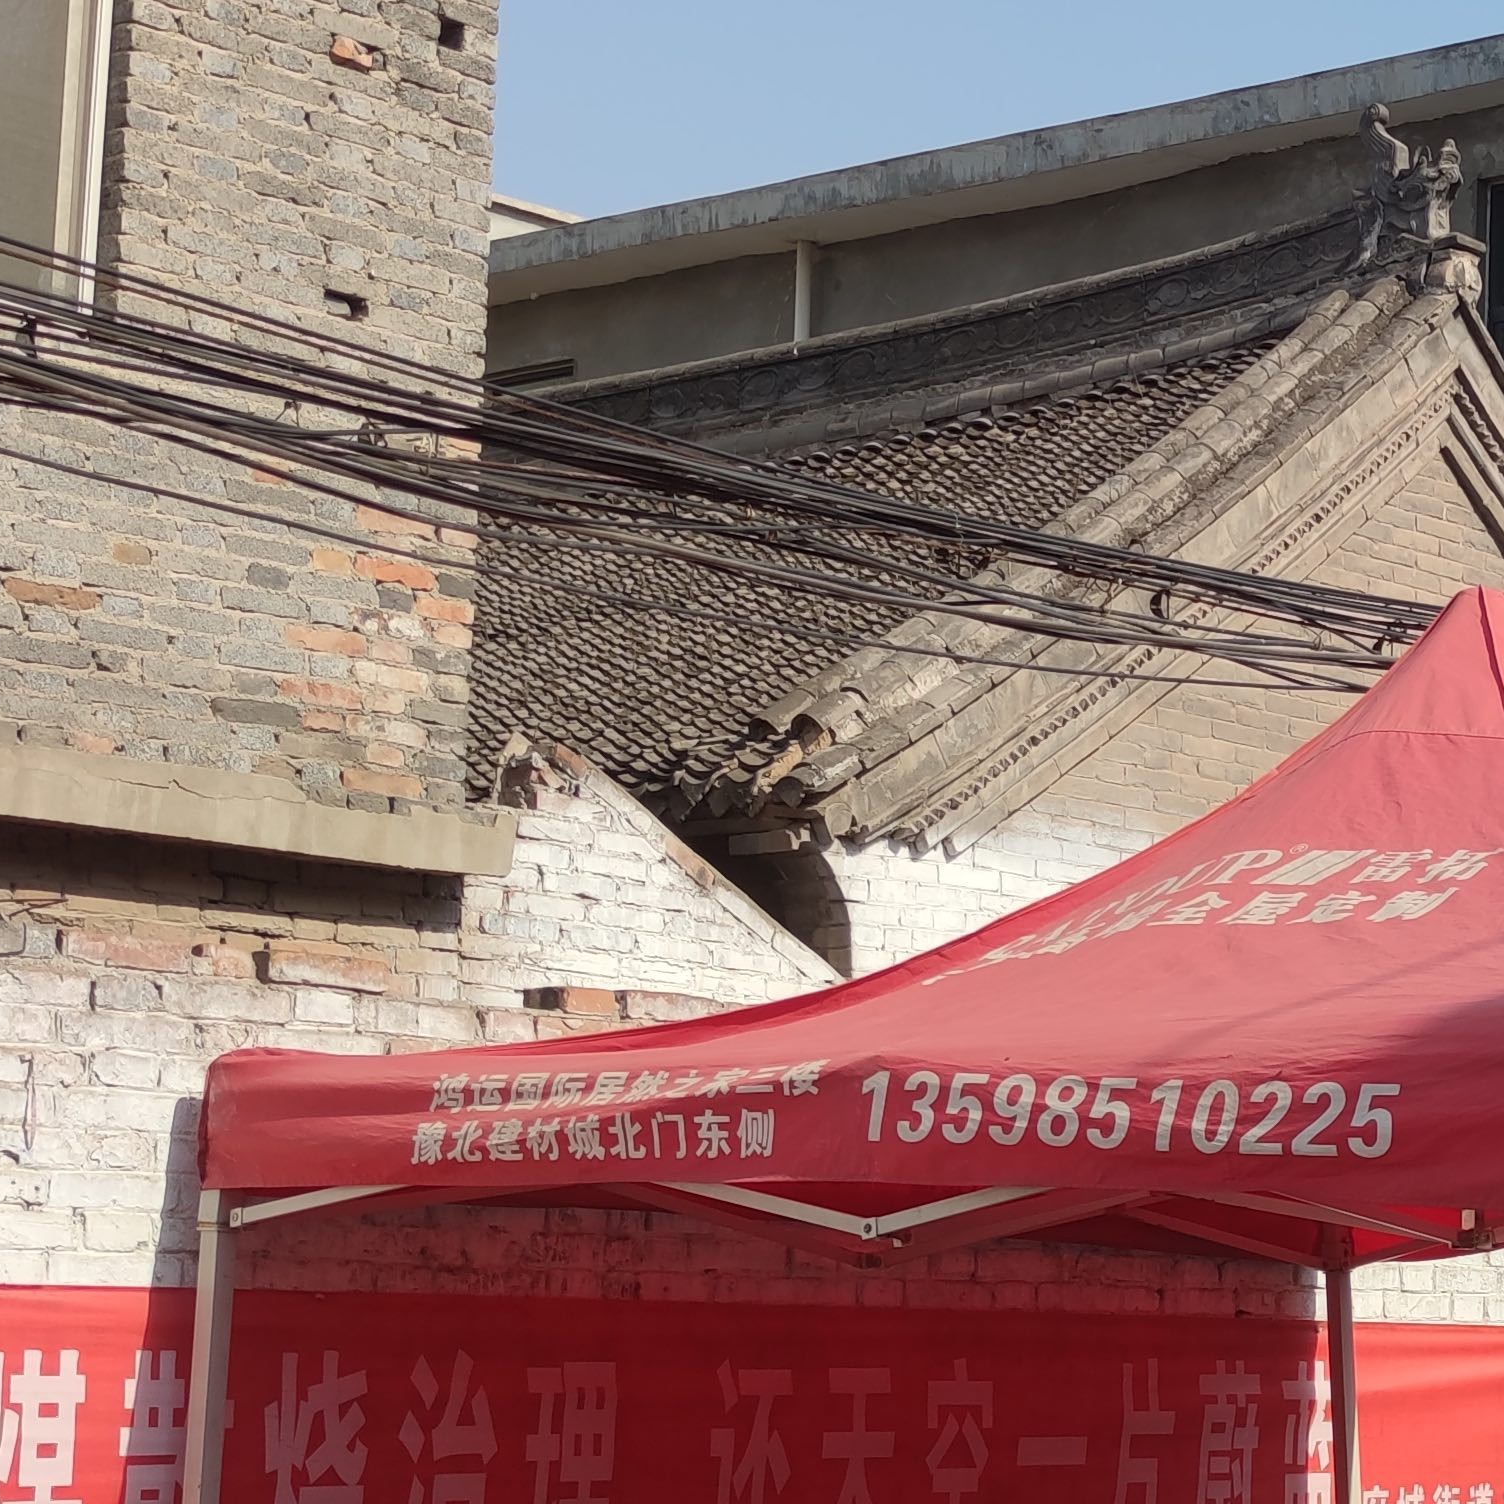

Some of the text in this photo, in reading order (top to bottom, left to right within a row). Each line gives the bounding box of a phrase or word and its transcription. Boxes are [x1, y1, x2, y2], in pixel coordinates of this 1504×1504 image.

[1353, 847, 1504, 884] 雷拓
[429, 1059, 832, 1114] 鸿运国际居然之家三楼
[860, 1068, 1403, 1160] 13598510225
[410, 1108, 775, 1165] 豫北建材城北门东侧
